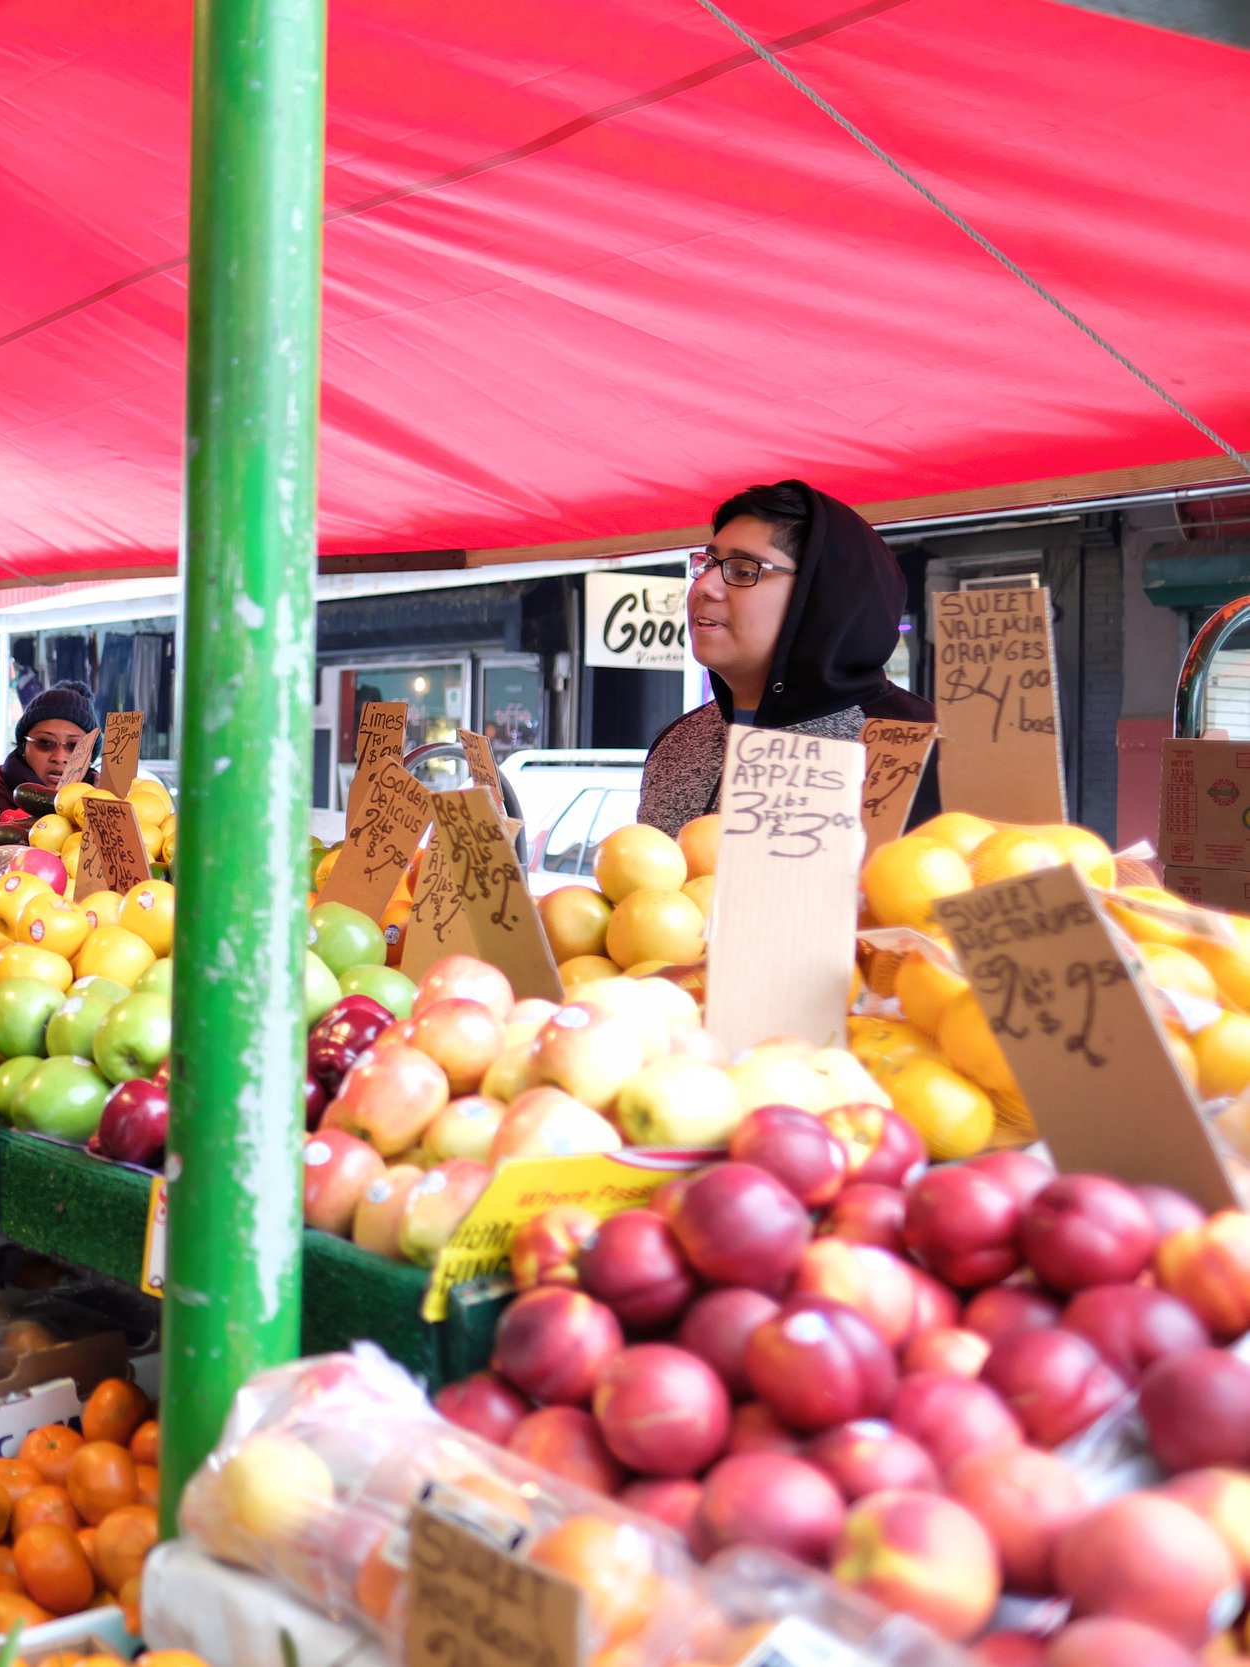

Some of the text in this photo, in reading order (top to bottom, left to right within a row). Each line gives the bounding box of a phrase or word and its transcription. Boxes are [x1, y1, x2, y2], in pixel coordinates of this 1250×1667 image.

[940, 590, 1035, 617] SWEET
[939, 614, 1044, 640] VALENCIA
[941, 640, 1046, 665] ORANGES
[360, 701, 403, 731] Limes
[736, 729, 821, 764] GALA
[379, 762, 430, 817] Golden
[731, 763, 846, 791] APPLES
[86, 799, 127, 820] Sweet
[431, 792, 473, 827] Red
[937, 876, 1045, 932] SWEET
